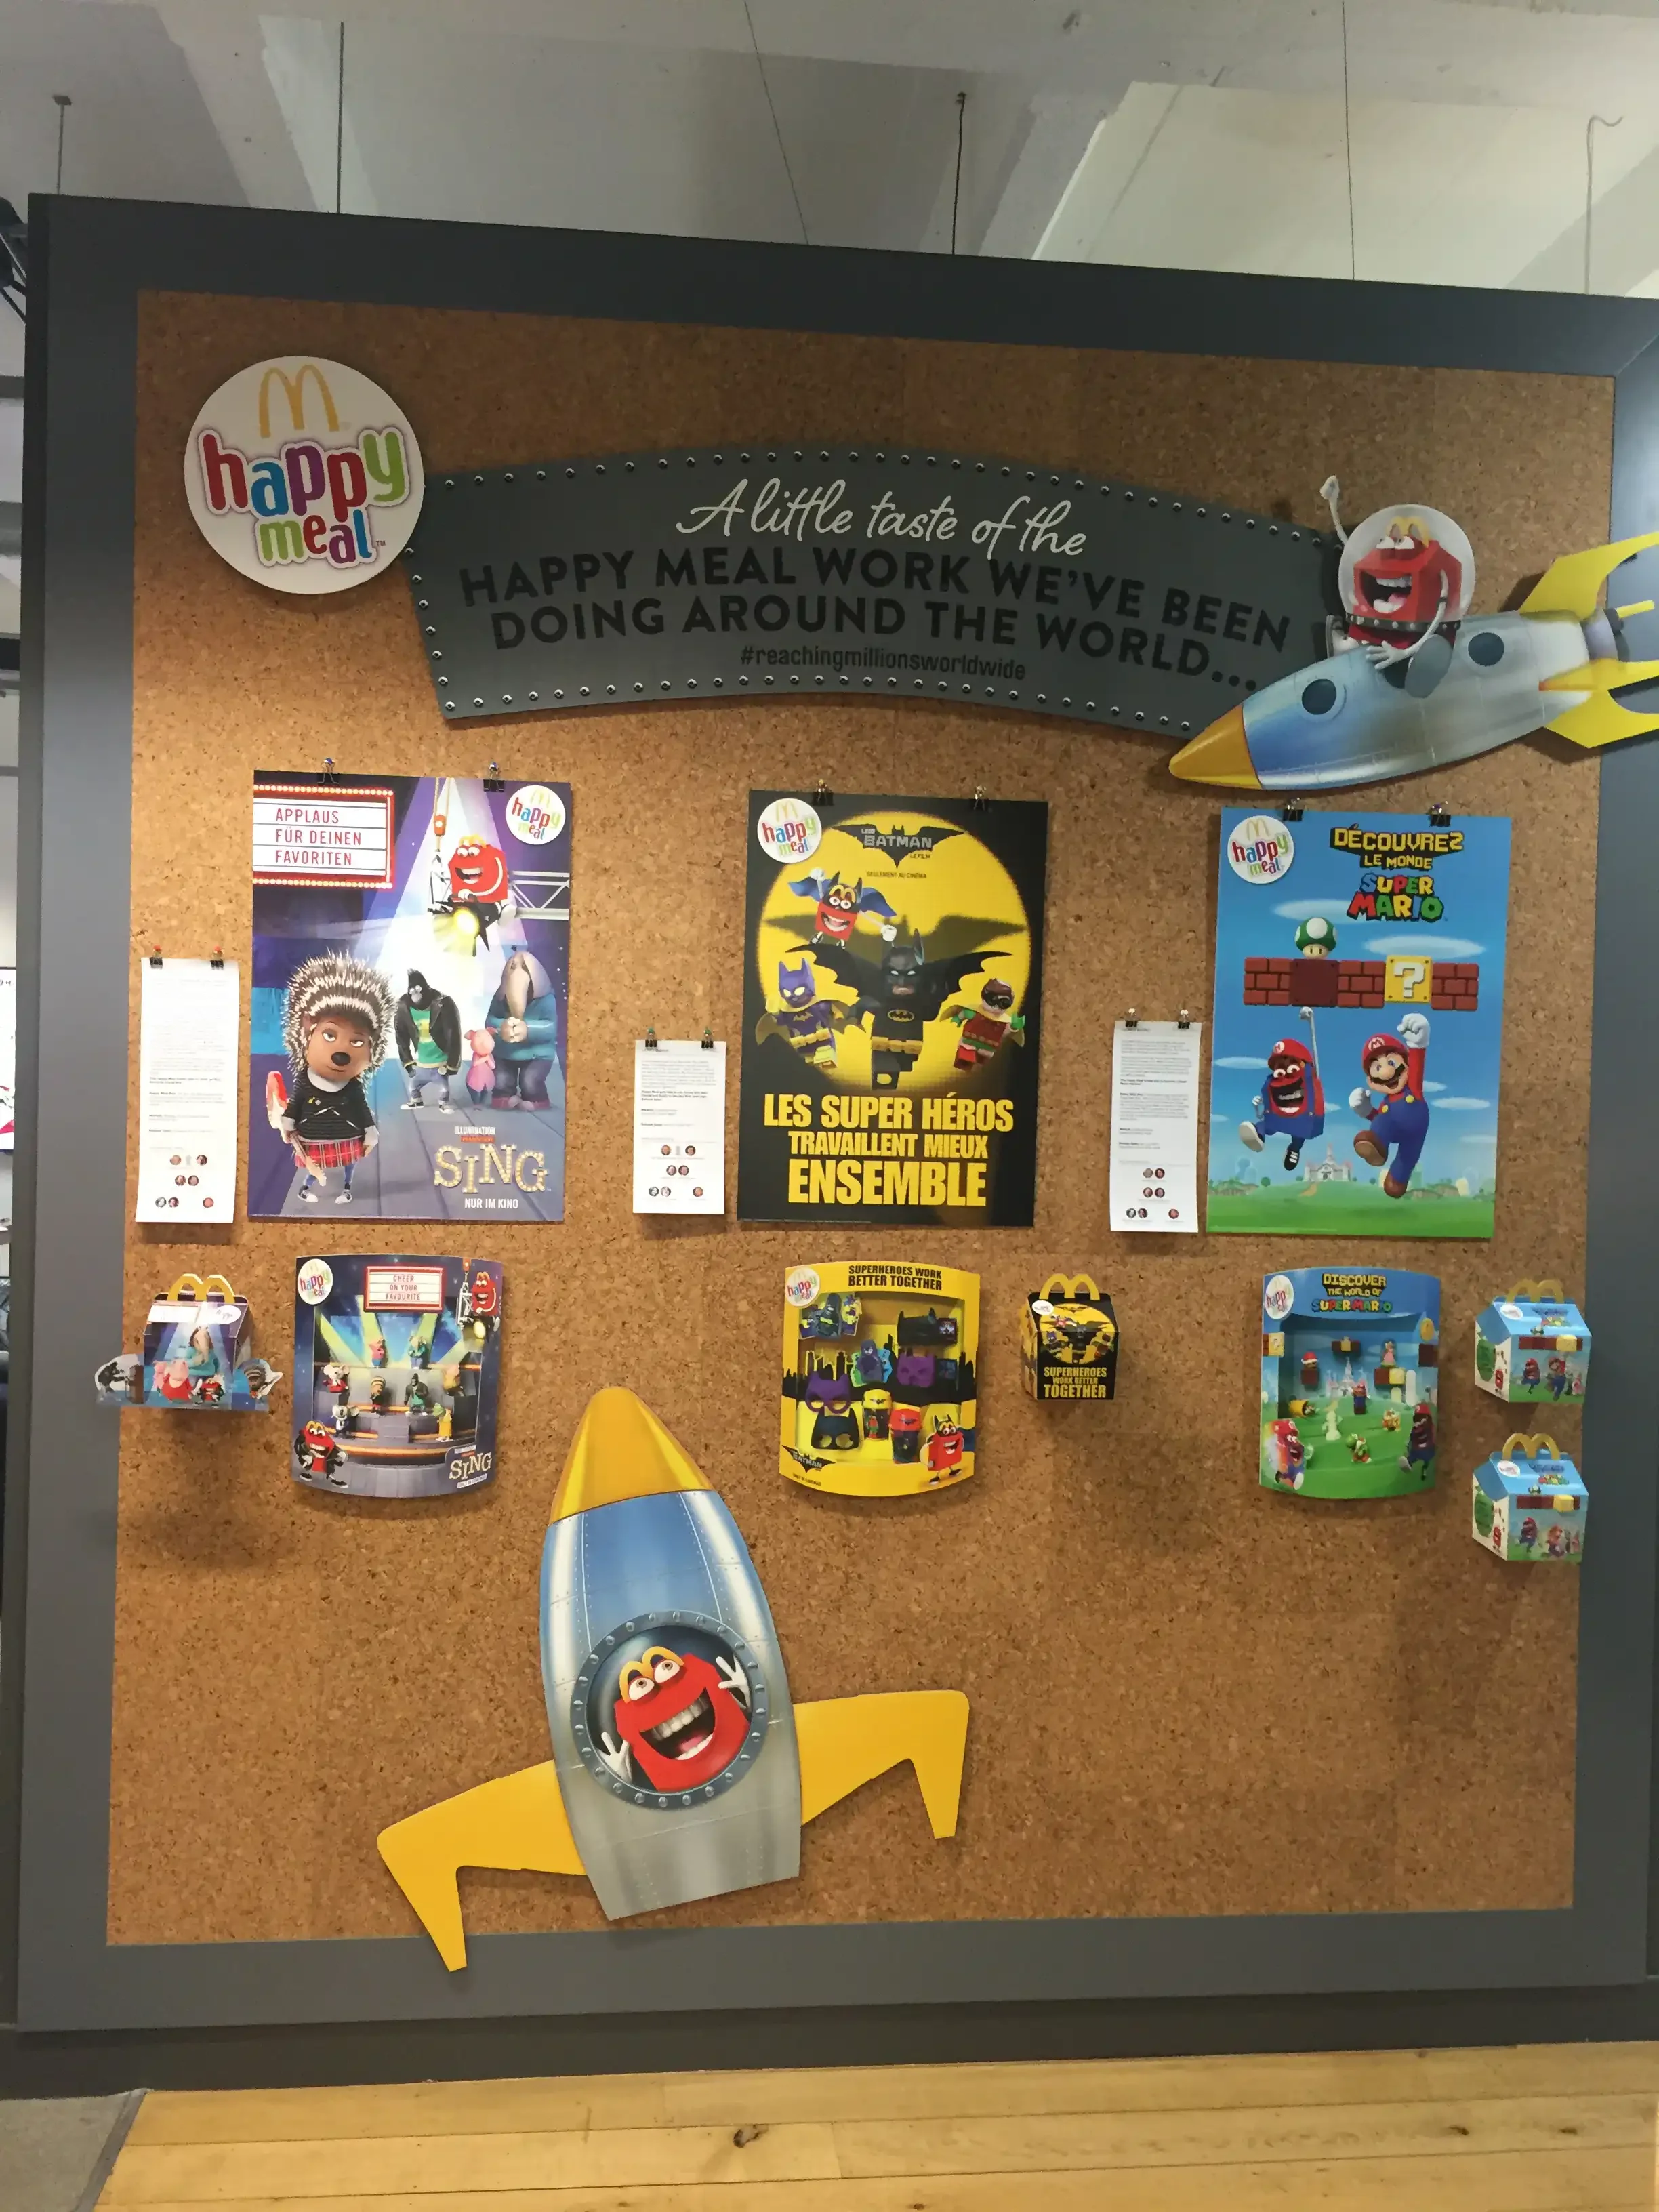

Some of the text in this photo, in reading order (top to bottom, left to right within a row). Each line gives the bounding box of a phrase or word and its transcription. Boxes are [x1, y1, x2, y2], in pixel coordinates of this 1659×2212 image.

[202, 432, 405, 522] happy
[676, 478, 1086, 560] A little taste of the
[259, 509, 373, 564] meal
[459, 547, 1290, 653] HAPPY MEAL WORK WE'VE BEEN
[491, 598, 664, 650] DOING
[682, 594, 905, 634] AROUND
[924, 601, 1018, 645] THE
[741, 645, 1026, 680] #reachingmillionsworldwide
[275, 808, 340, 825] APPLAUS
[512, 797, 562, 830] happy
[276, 826, 362, 846] FÜR DEINEN
[762, 817, 817, 845] happy
[864, 835, 932, 848] BATMAN
[1333, 823, 1465, 853] DÉCOUVREZ
[275, 850, 353, 867] FAVORITEN
[779, 841, 810, 856] meal
[1231, 834, 1289, 864] happy
[1250, 857, 1282, 877] meal
[1364, 854, 1433, 870] LE MONDE
[1359, 872, 1434, 895] SUPER
[1347, 892, 1445, 922] MARIO
[764, 1092, 1015, 1132] LES SUPER HÉROS
[787, 1130, 988, 1159] TRAVAILLENT MIEUX
[434, 1143, 550, 1194] SING
[787, 1158, 987, 1207] ENSEMBLE
[464, 1197, 518, 1209] NUR IM KINO
[300, 1269, 331, 1291] happy
[848, 1265, 941, 1279] SUPERHEROES WORK
[848, 1275, 942, 1290] BETTER TOGETHER
[1323, 1273, 1387, 1286] DISCOVER
[389, 1284, 399, 1292] ON
[787, 1277, 817, 1296] happy
[1328, 1288, 1342, 1296] THE
[1344, 1288, 1370, 1296] WORLD
[1311, 1299, 1351, 1313] SUPER
[1044, 1366, 1107, 1378] SUPERHEROES
[1044, 1385, 1107, 1398] TOGETHER
[449, 1452, 492, 1480] SING
